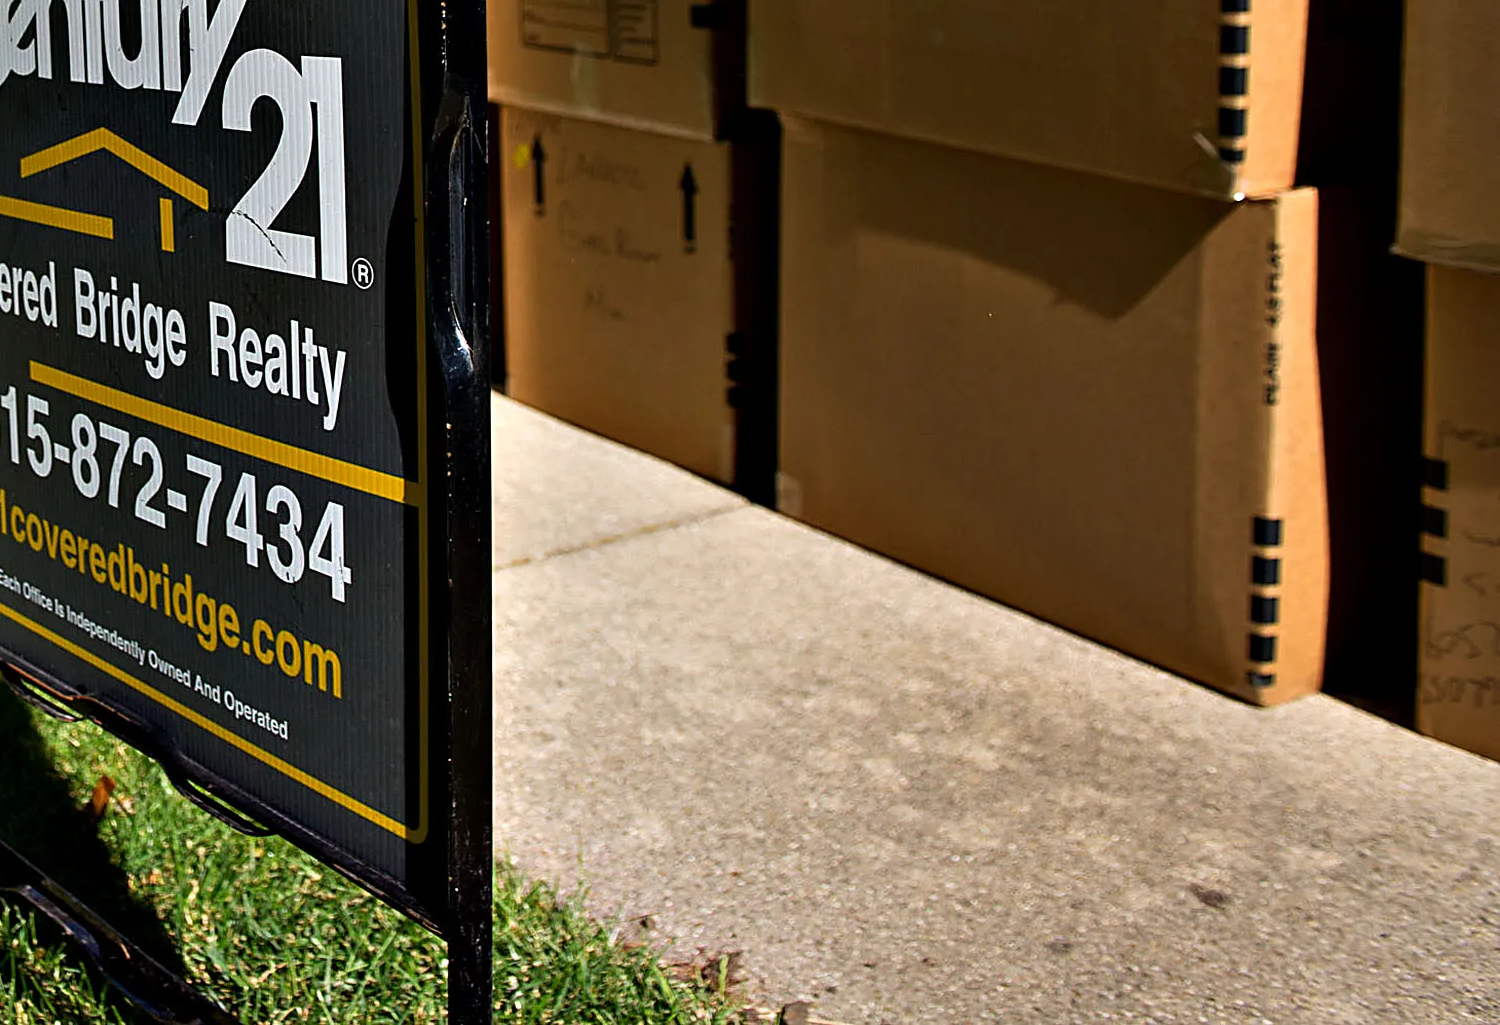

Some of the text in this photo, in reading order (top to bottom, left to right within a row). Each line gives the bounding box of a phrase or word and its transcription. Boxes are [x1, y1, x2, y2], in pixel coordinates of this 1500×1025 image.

[221, 48, 348, 285] 21
[74, 266, 187, 380] Bridge
[208, 300, 347, 432] Realty
[23, 581, 54, 613] Office
[54, 598, 66, 619] Is
[66, 604, 147, 667] Independently
[147, 650, 192, 688] Owned
[193, 674, 222, 704] And
[224, 690, 289, 741] Operated
